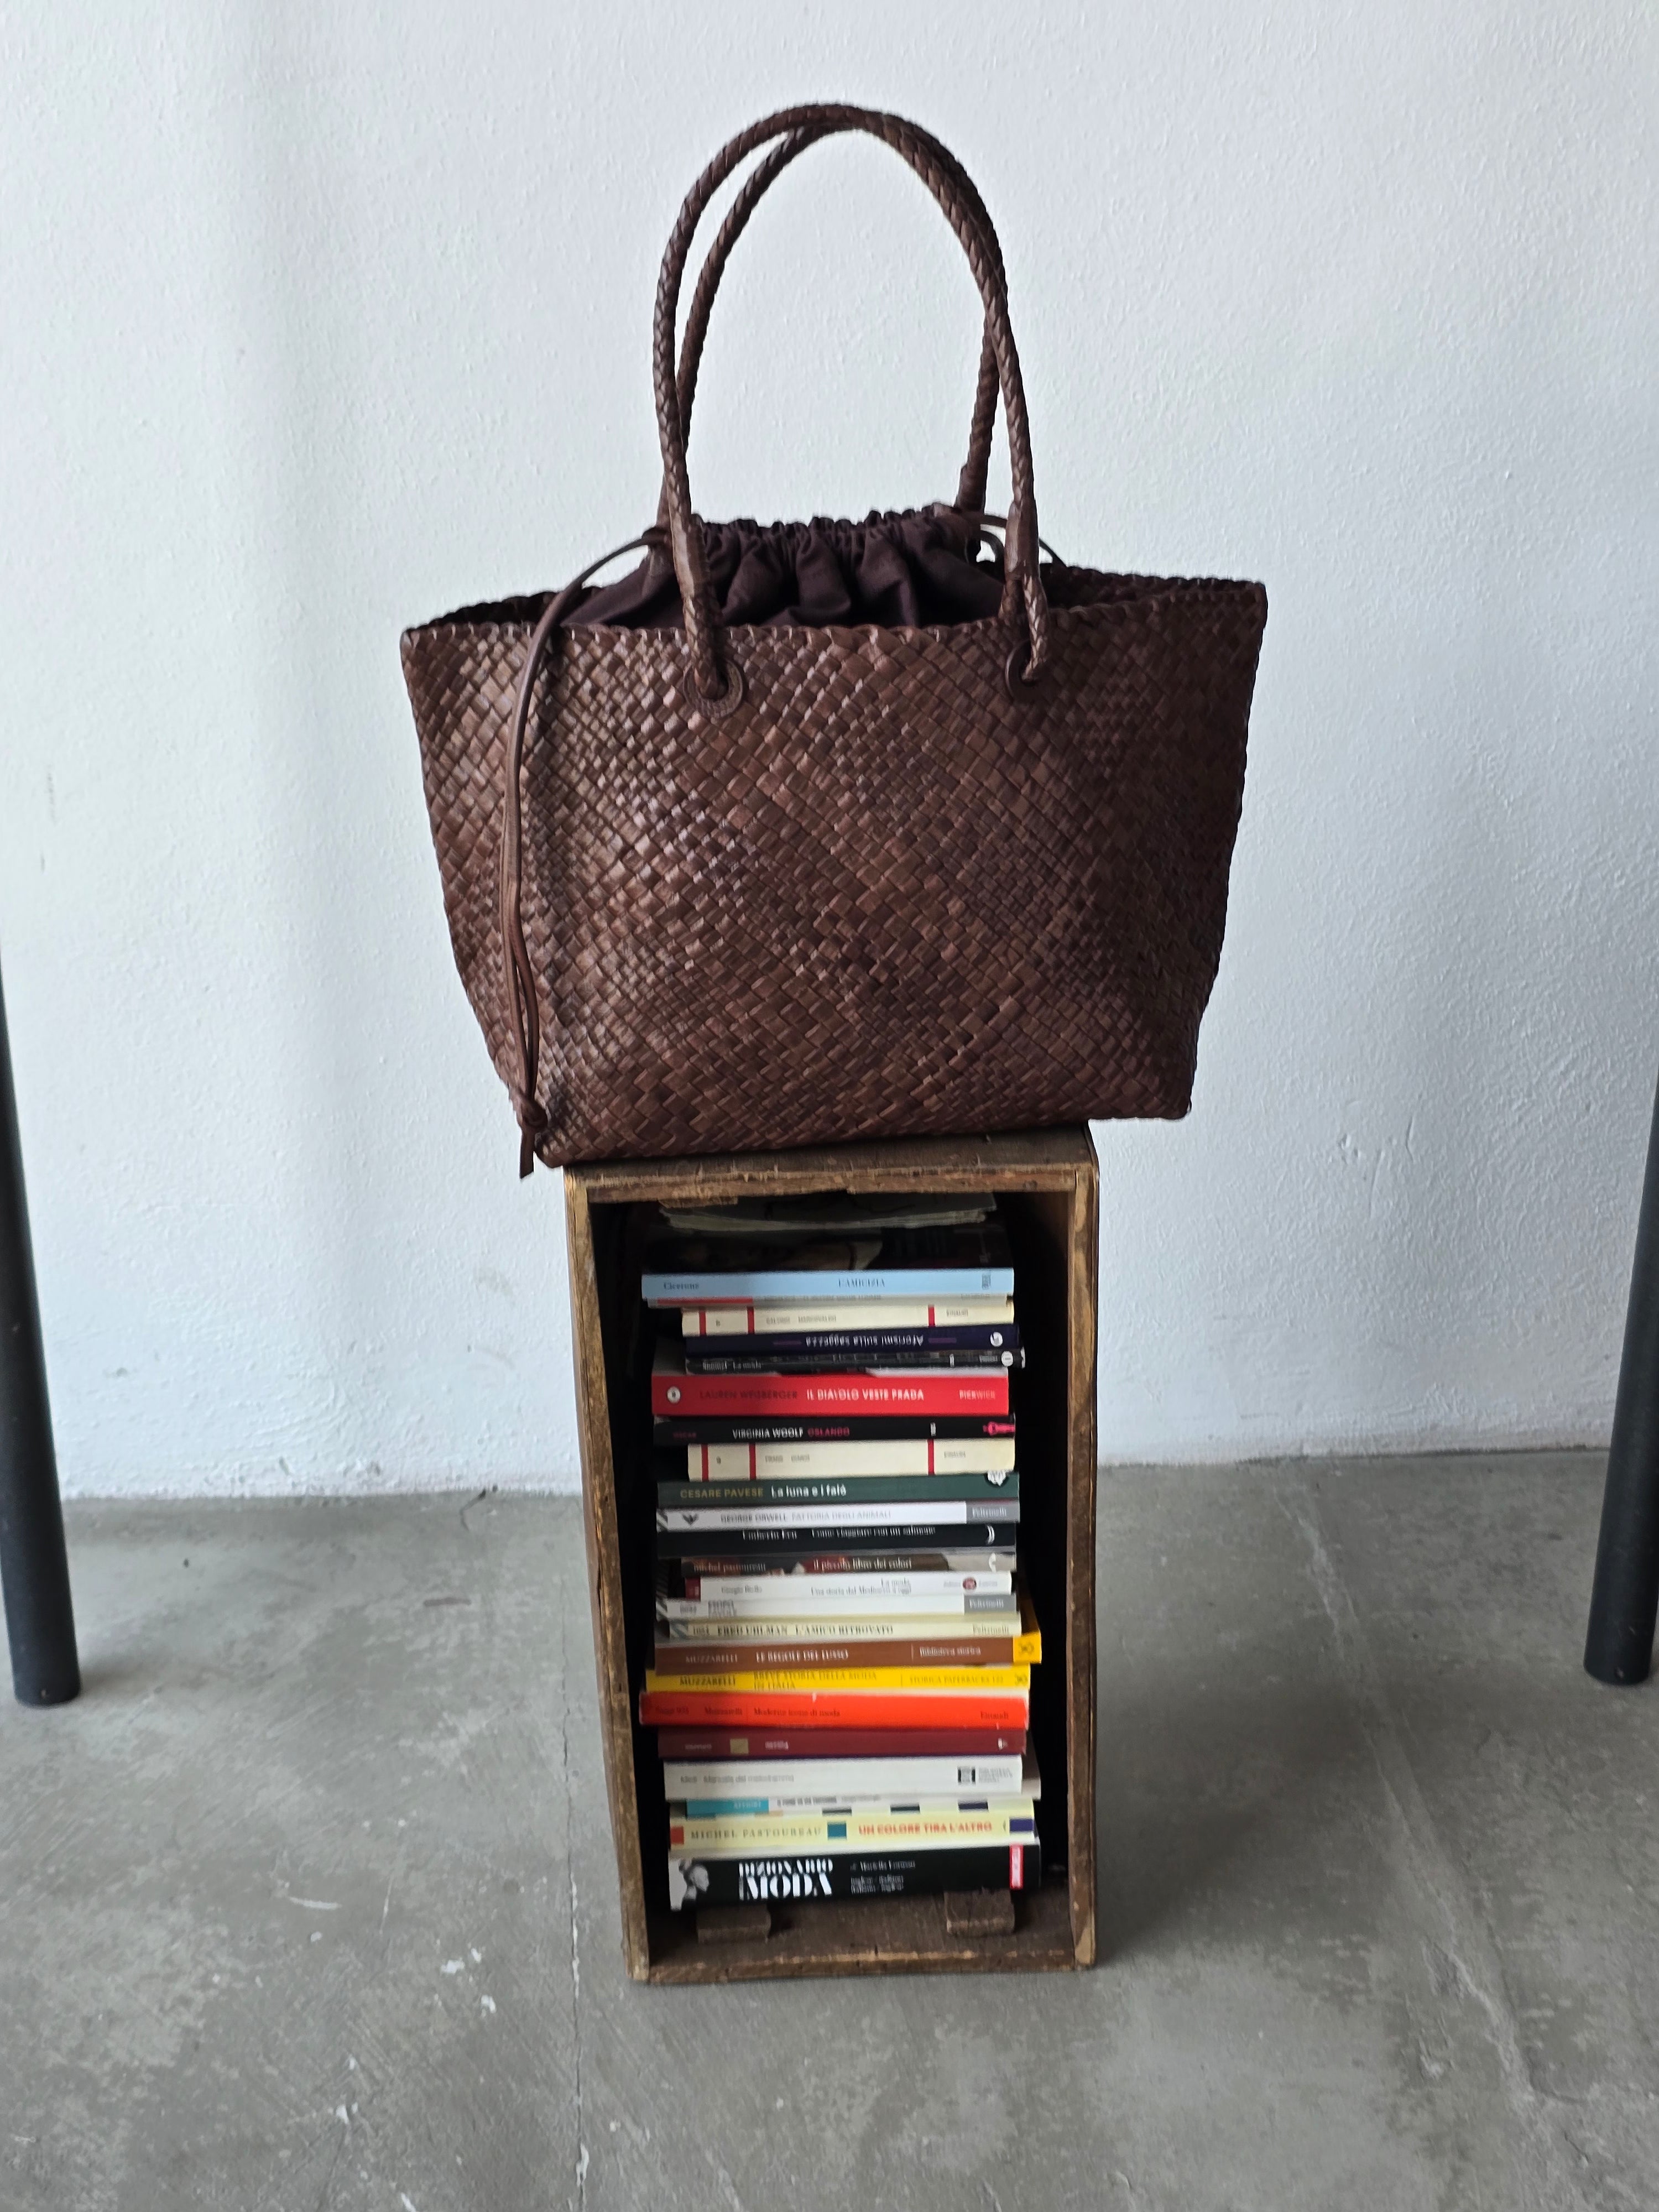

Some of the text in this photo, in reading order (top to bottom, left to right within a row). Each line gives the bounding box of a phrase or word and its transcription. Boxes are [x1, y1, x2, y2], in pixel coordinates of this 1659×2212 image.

[699, 1390, 737, 1400] LAUREN
[806, 1388, 924, 1401] IL DIAVOLO VESTE PRADA
[732, 1426, 850, 1440] VIRGINIA WOOLF ORLANDO
[680, 1486, 764, 1499] CESARE PAVESE
[770, 1484, 784, 1499] La
[785, 1484, 810, 1498] luna
[811, 1486, 818, 1497] e
[755, 1513, 786, 1522] ORWELL
[791, 1512, 830, 1521] FATTORIA
[832, 1512, 855, 1520] DEGLI
[859, 1510, 891, 1520] ANIMALI
[685, 1653, 738, 1664] MUZZARELLI
[679, 1676, 736, 1686] MUZZARELLI
[691, 1827, 822, 1839] MICHEL PASTOUREAU
[858, 1822, 993, 1835] UN COLORE TIRA L'ALTRO
